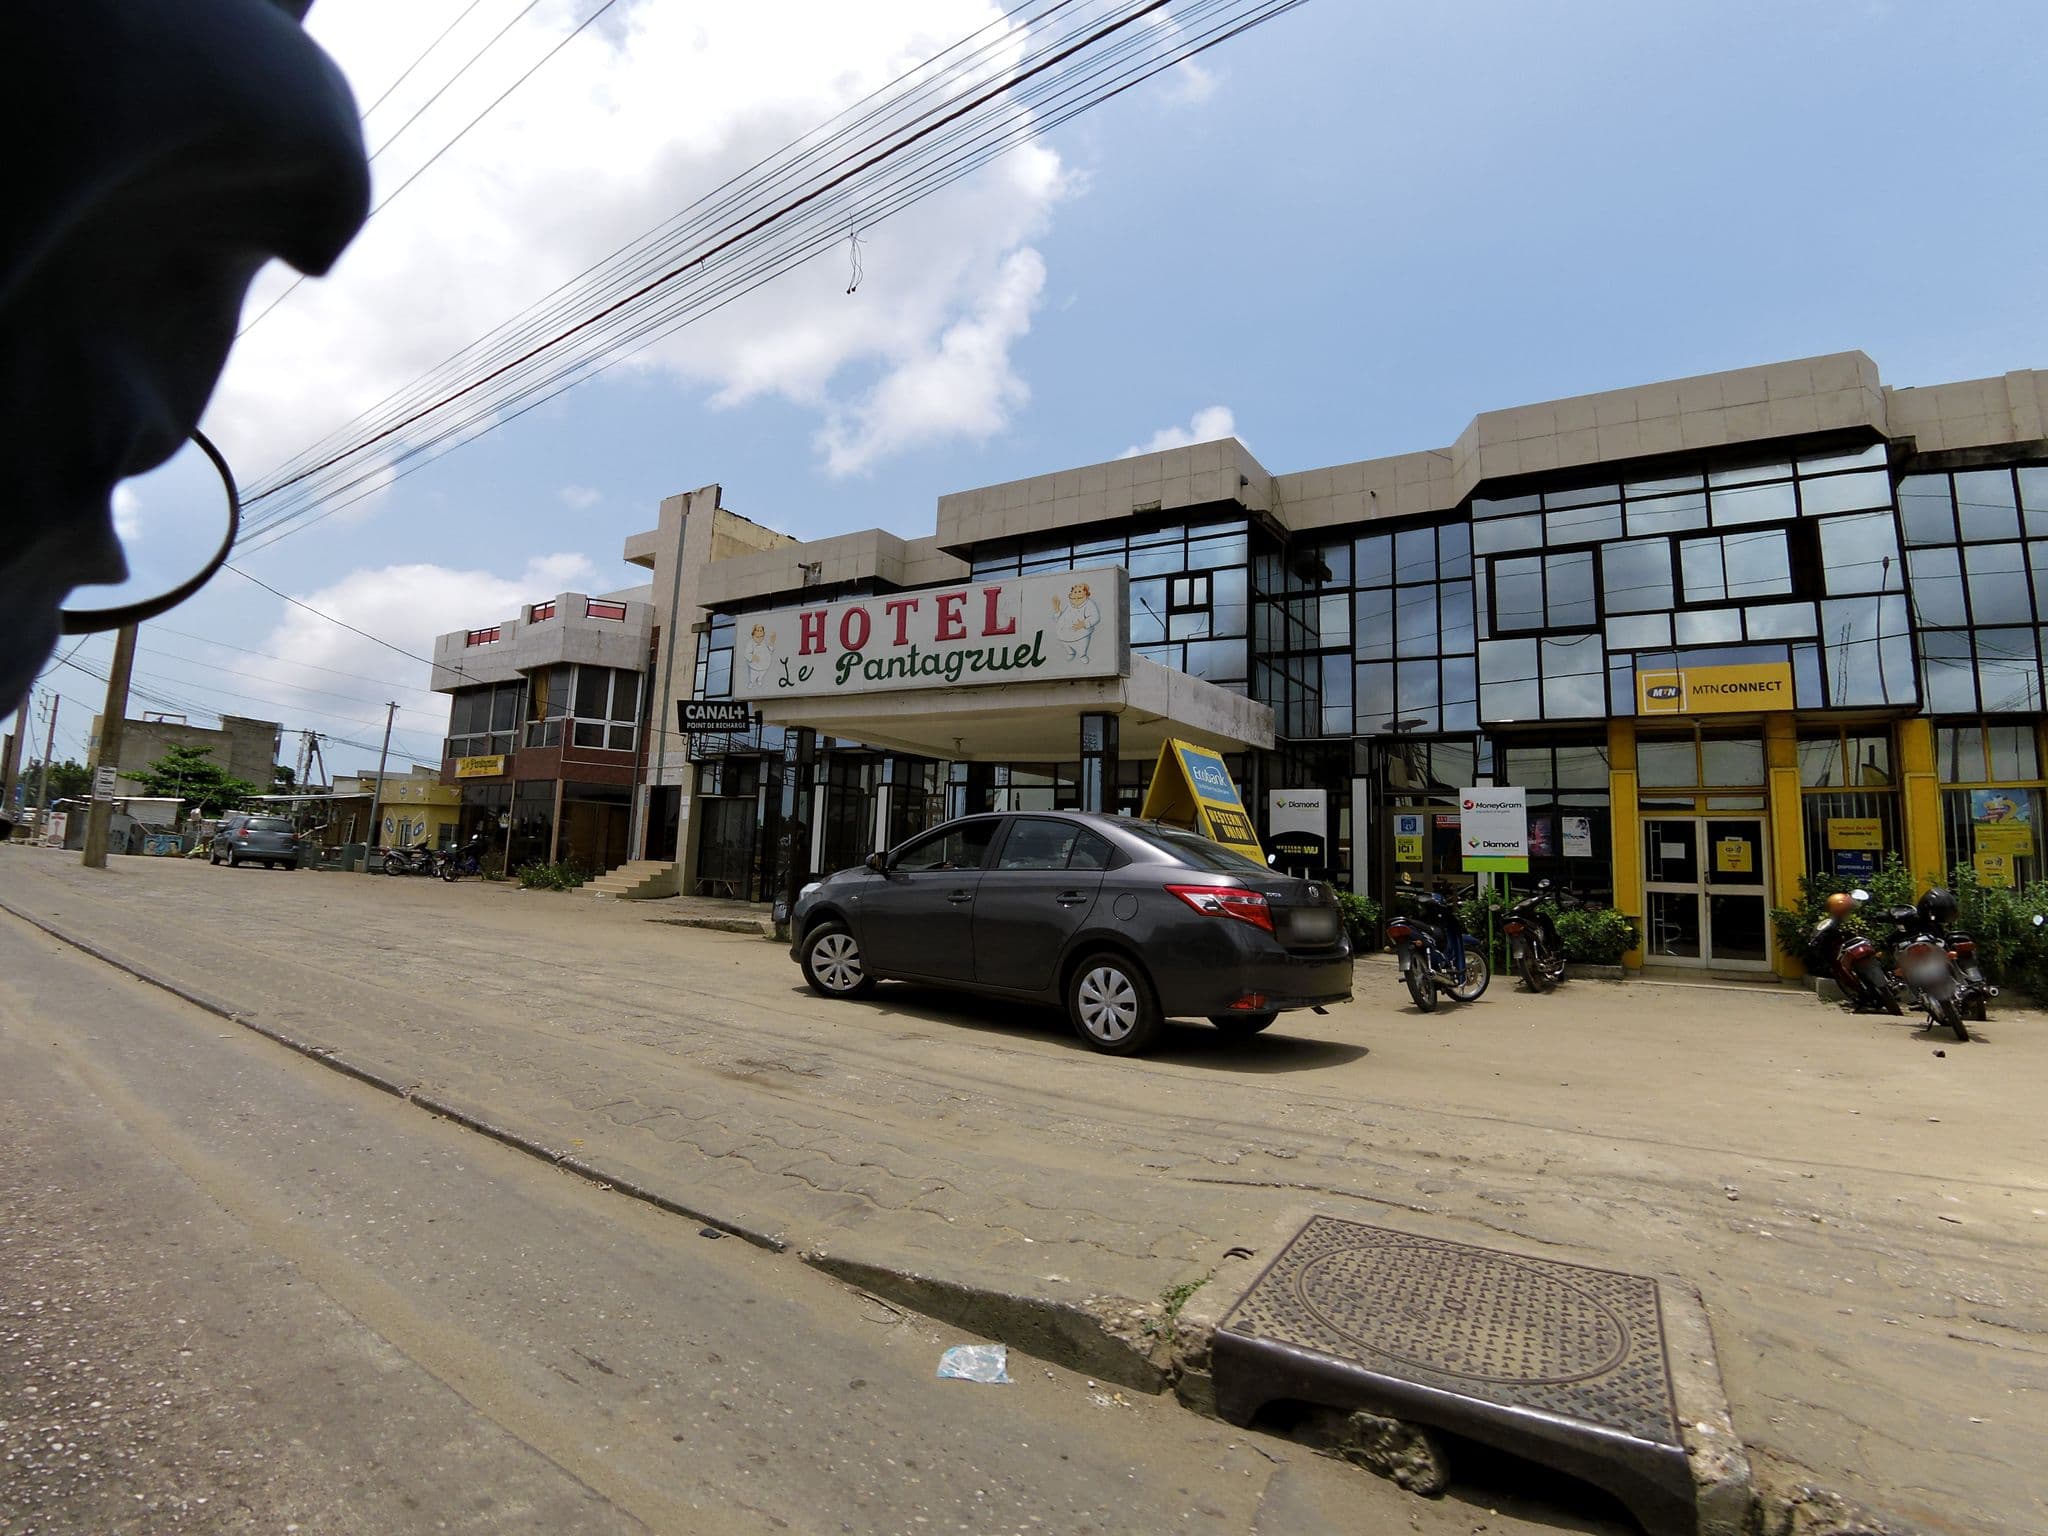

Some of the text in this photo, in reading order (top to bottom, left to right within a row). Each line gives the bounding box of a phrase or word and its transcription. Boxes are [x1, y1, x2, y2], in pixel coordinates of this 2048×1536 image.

[798, 586, 1016, 656] HOTEL
[778, 629, 1047, 688] Le Pantagruel
[1652, 687, 1677, 697] MTN
[685, 704, 745, 720] CANAL+
[1192, 765, 1228, 787] Ecobank
[1288, 799, 1320, 808] Diamond
[1475, 801, 1522, 811] MoneyGram
[1206, 808, 1244, 827] WESTERN
[1222, 824, 1250, 841] UNION
[1482, 840, 1520, 848] Diamond
